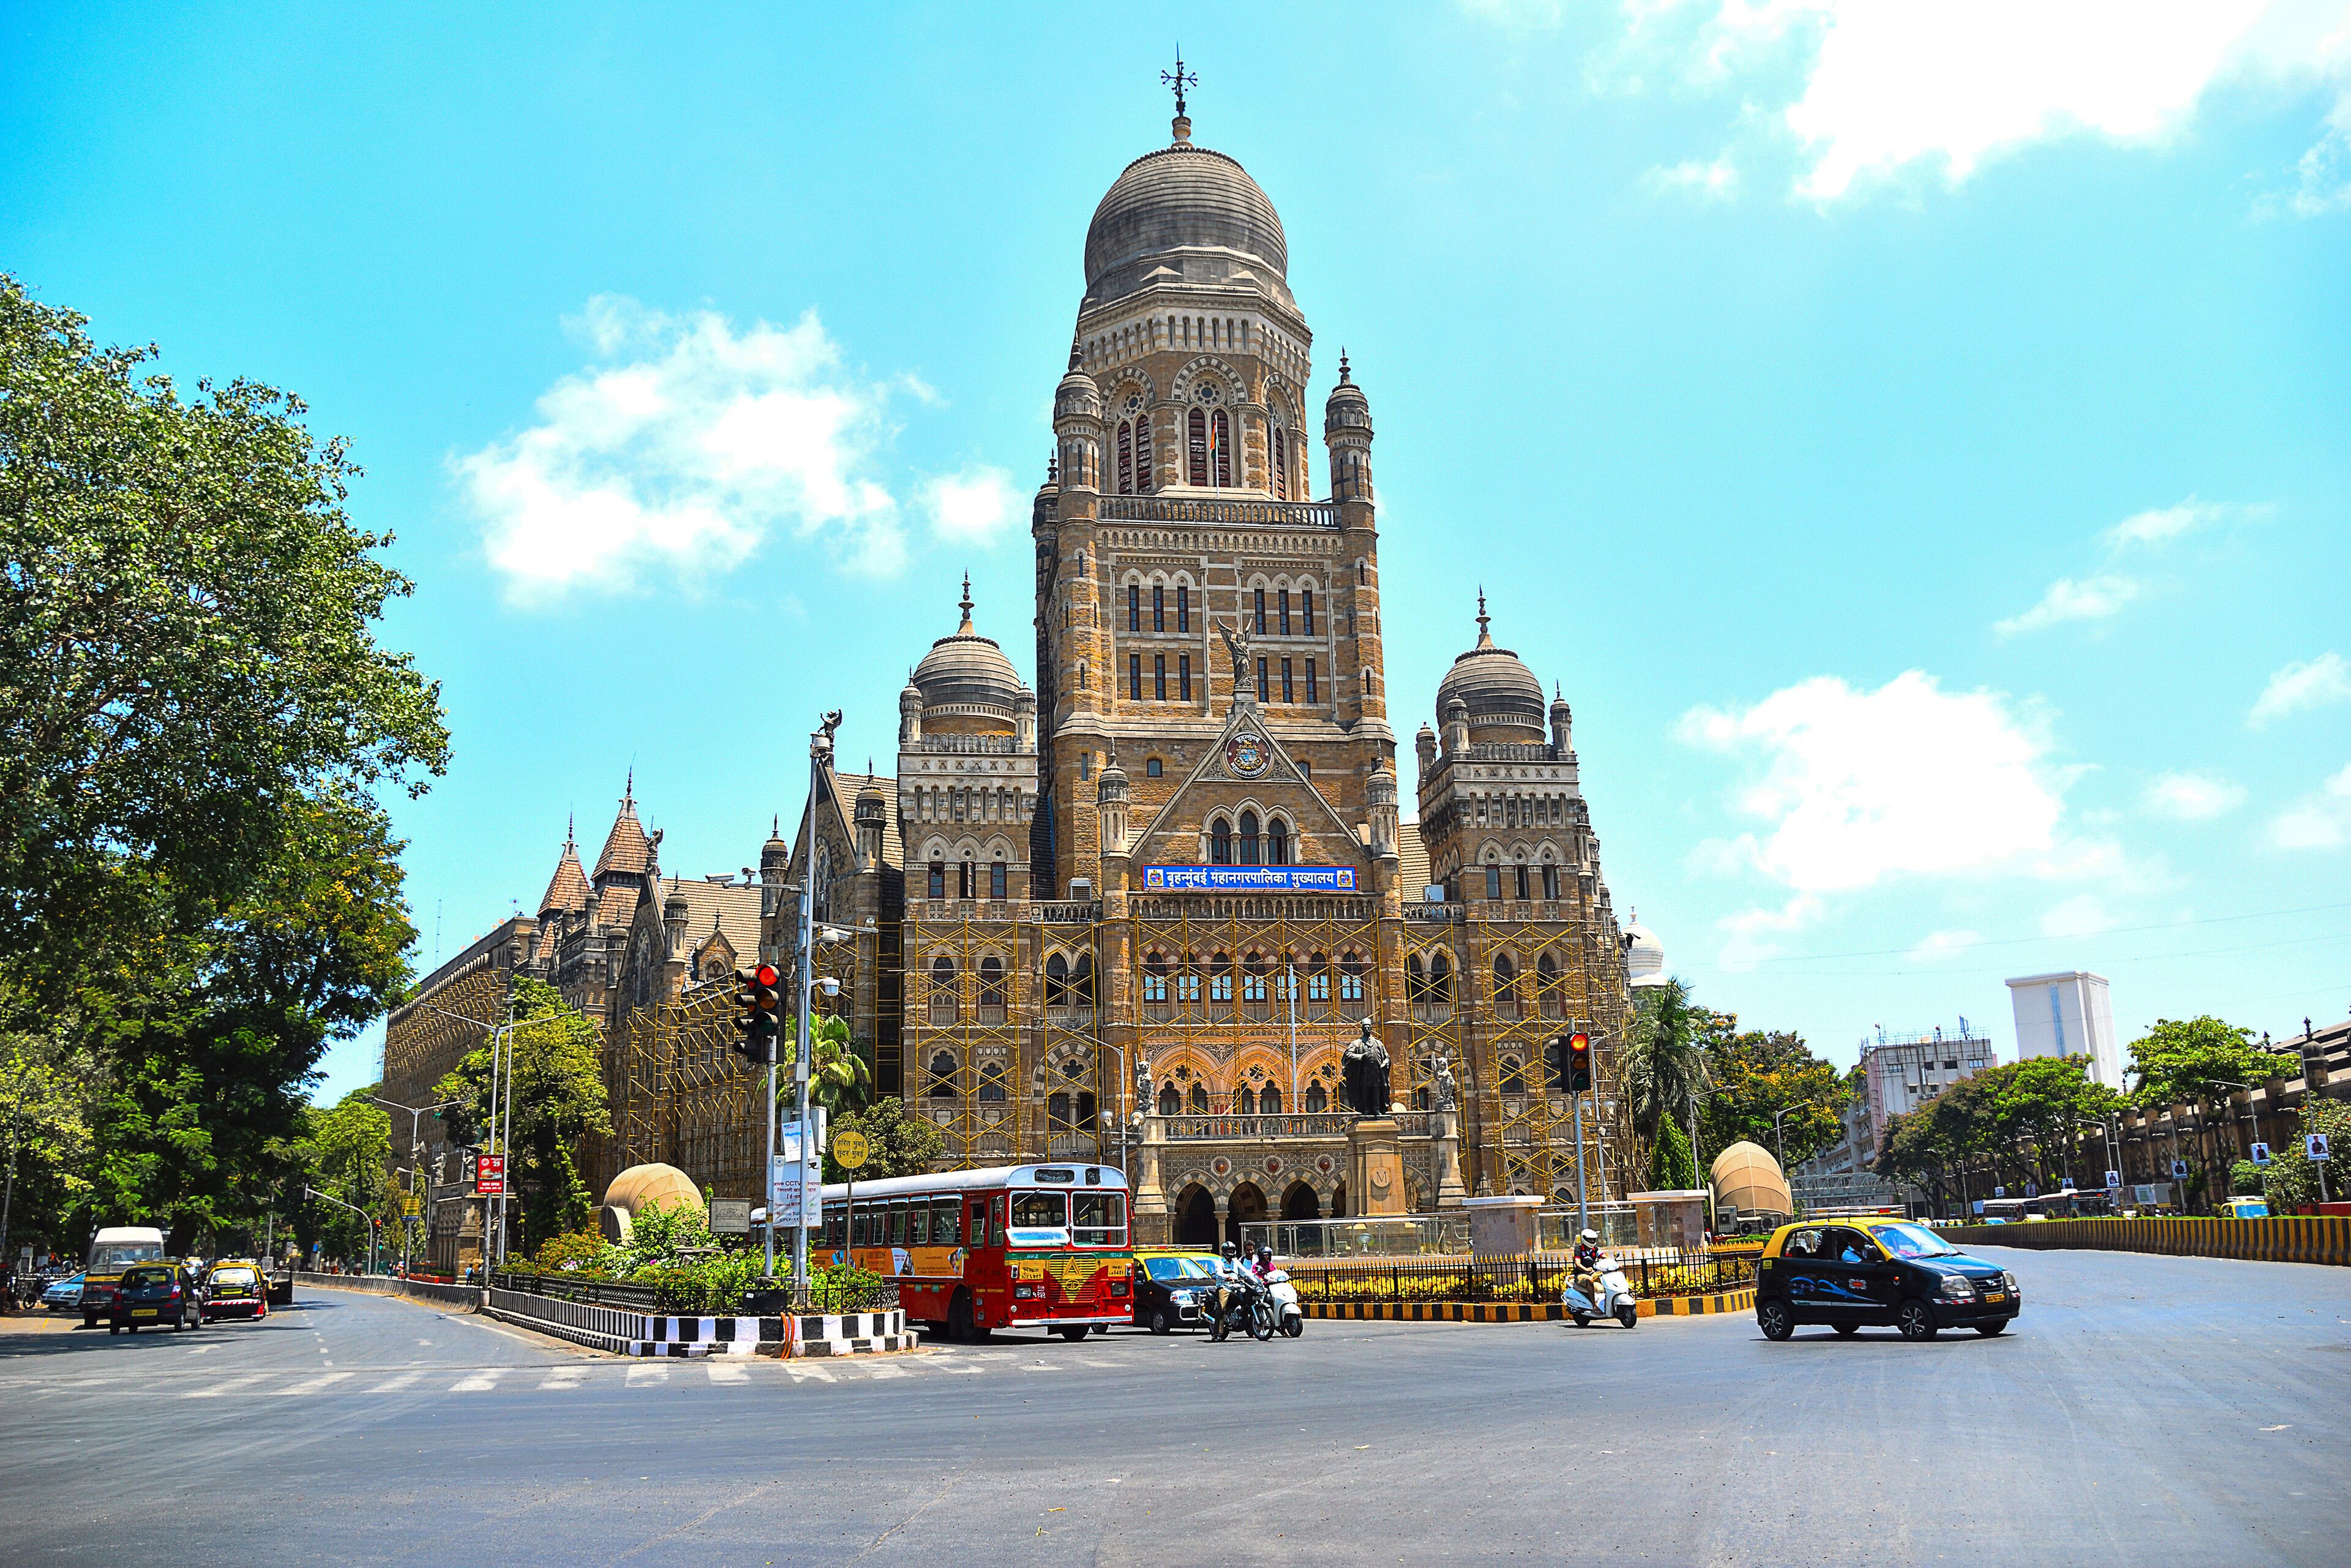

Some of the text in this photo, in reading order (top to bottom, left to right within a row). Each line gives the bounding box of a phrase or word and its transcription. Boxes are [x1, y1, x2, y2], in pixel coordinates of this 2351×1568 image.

[1231, 762, 1267, 776] महानगरपालिका
[1166, 868, 1335, 888] बृहन्मुंबई महानगरपालिका मुख्यालय
[836, 1148, 849, 1158] सुंदर
[1376, 1171, 1387, 1184] M
